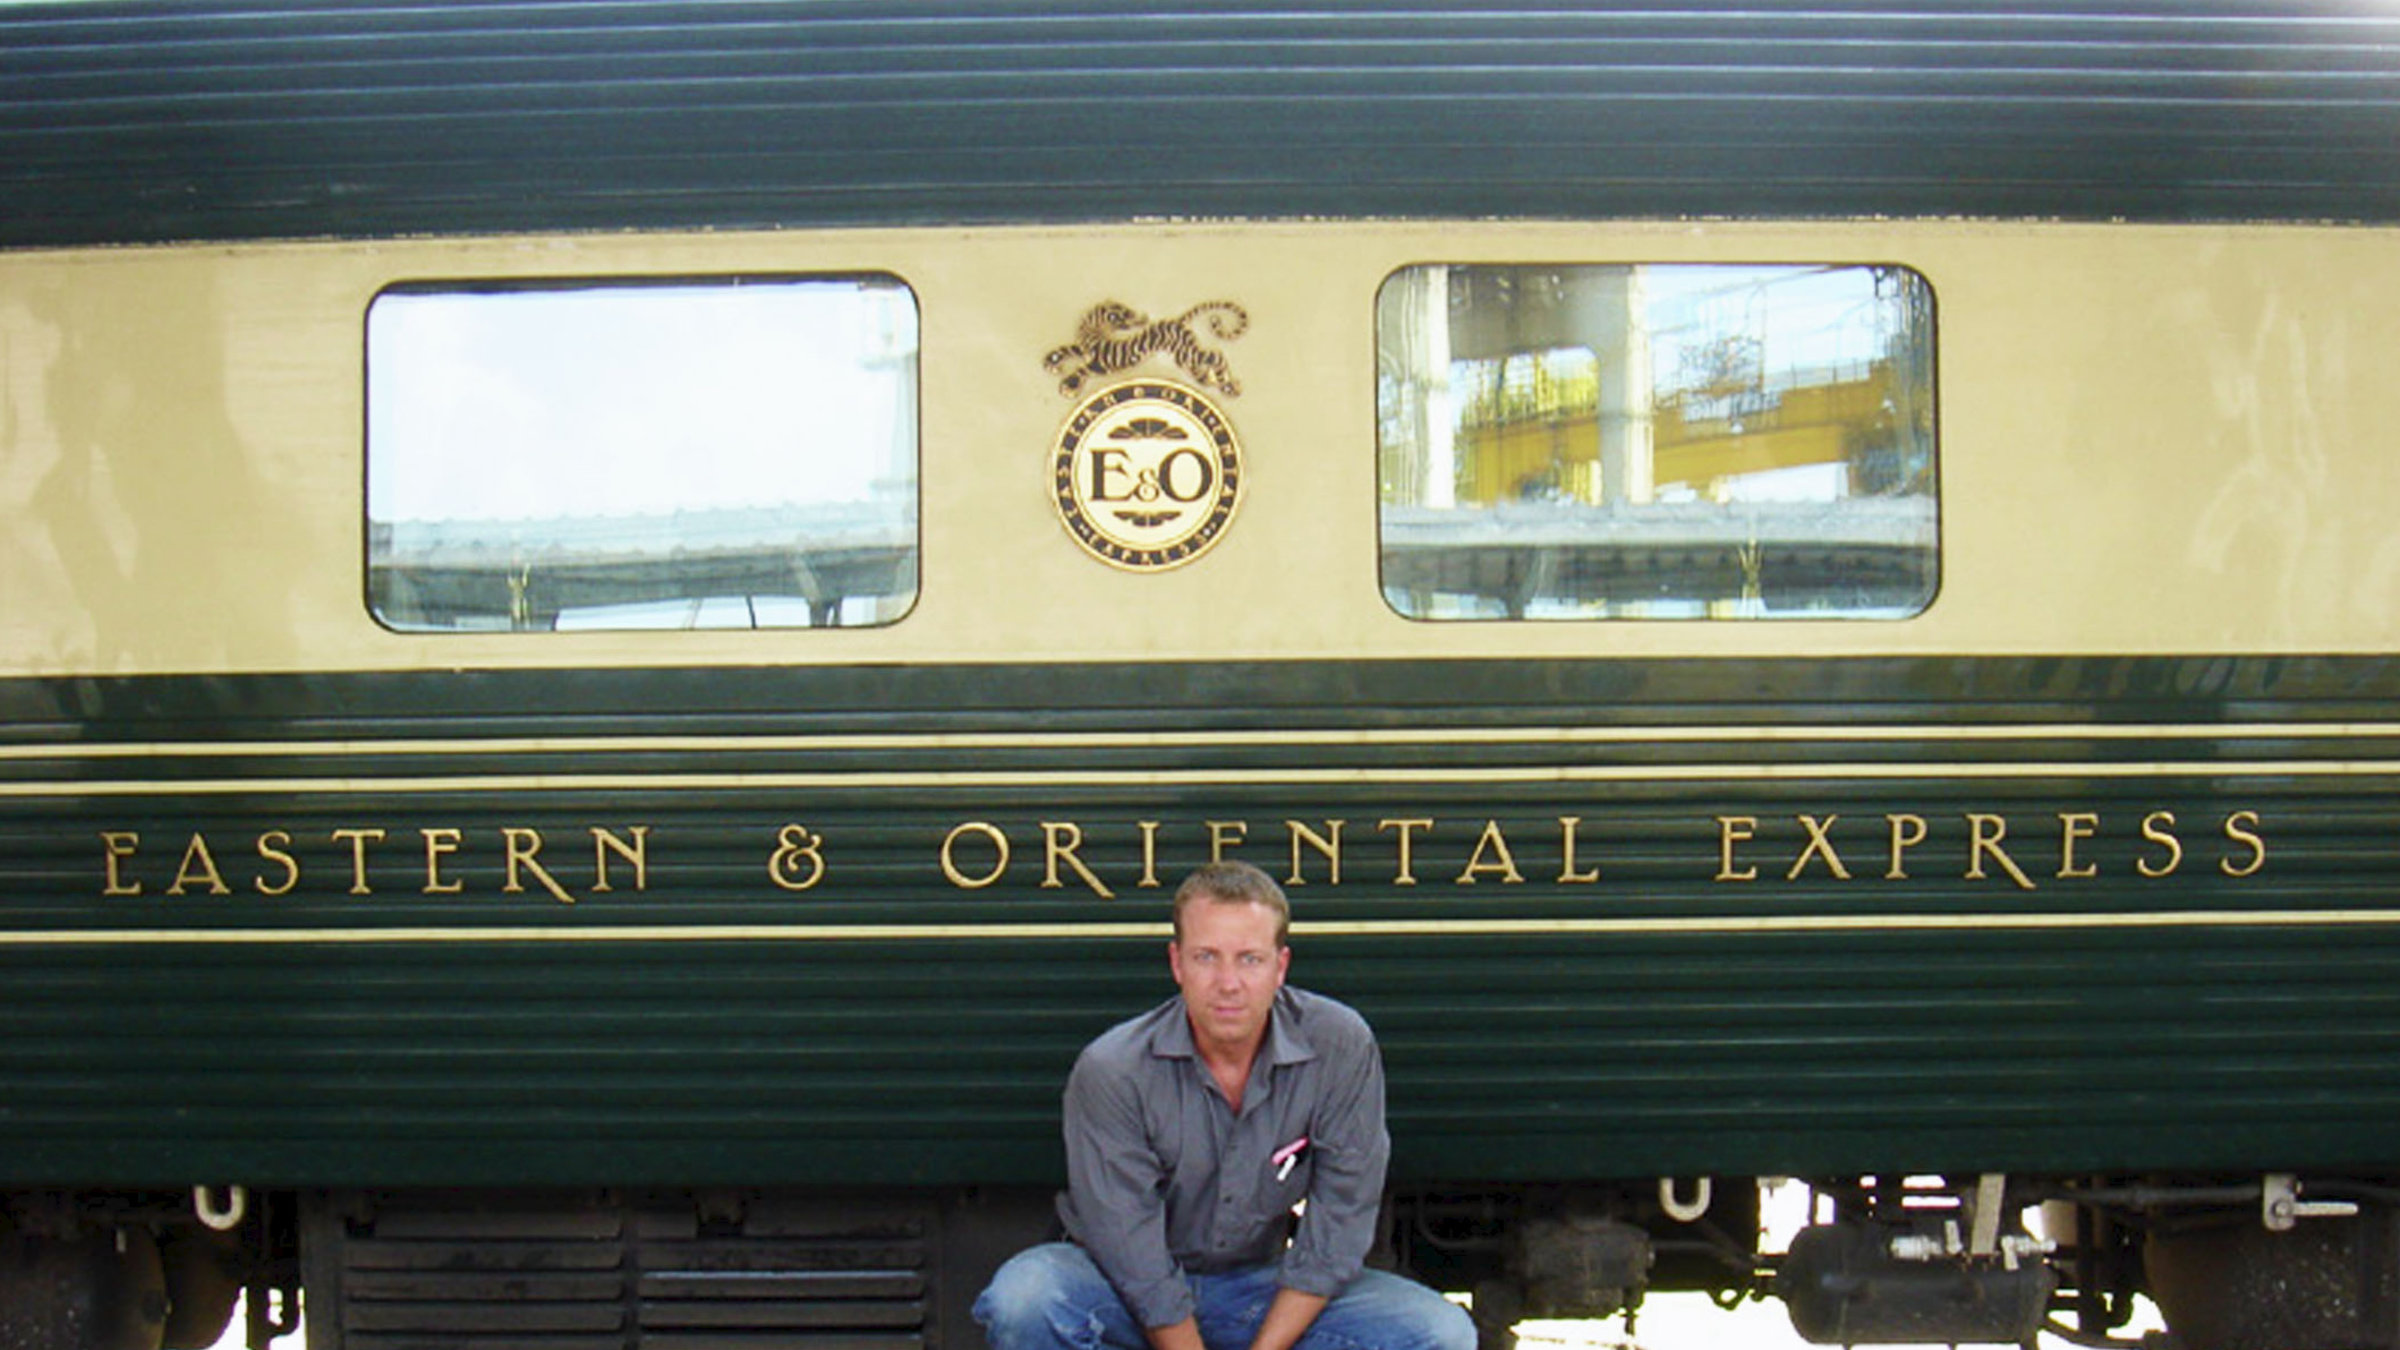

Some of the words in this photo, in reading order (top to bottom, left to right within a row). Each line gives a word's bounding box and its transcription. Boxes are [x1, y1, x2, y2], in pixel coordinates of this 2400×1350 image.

[1090, 447, 1214, 502] E&O
[101, 826, 649, 903] EASTERN
[768, 823, 825, 890] &
[940, 816, 1599, 898] ORIENTAL
[1714, 811, 2267, 890] EXPRESS
